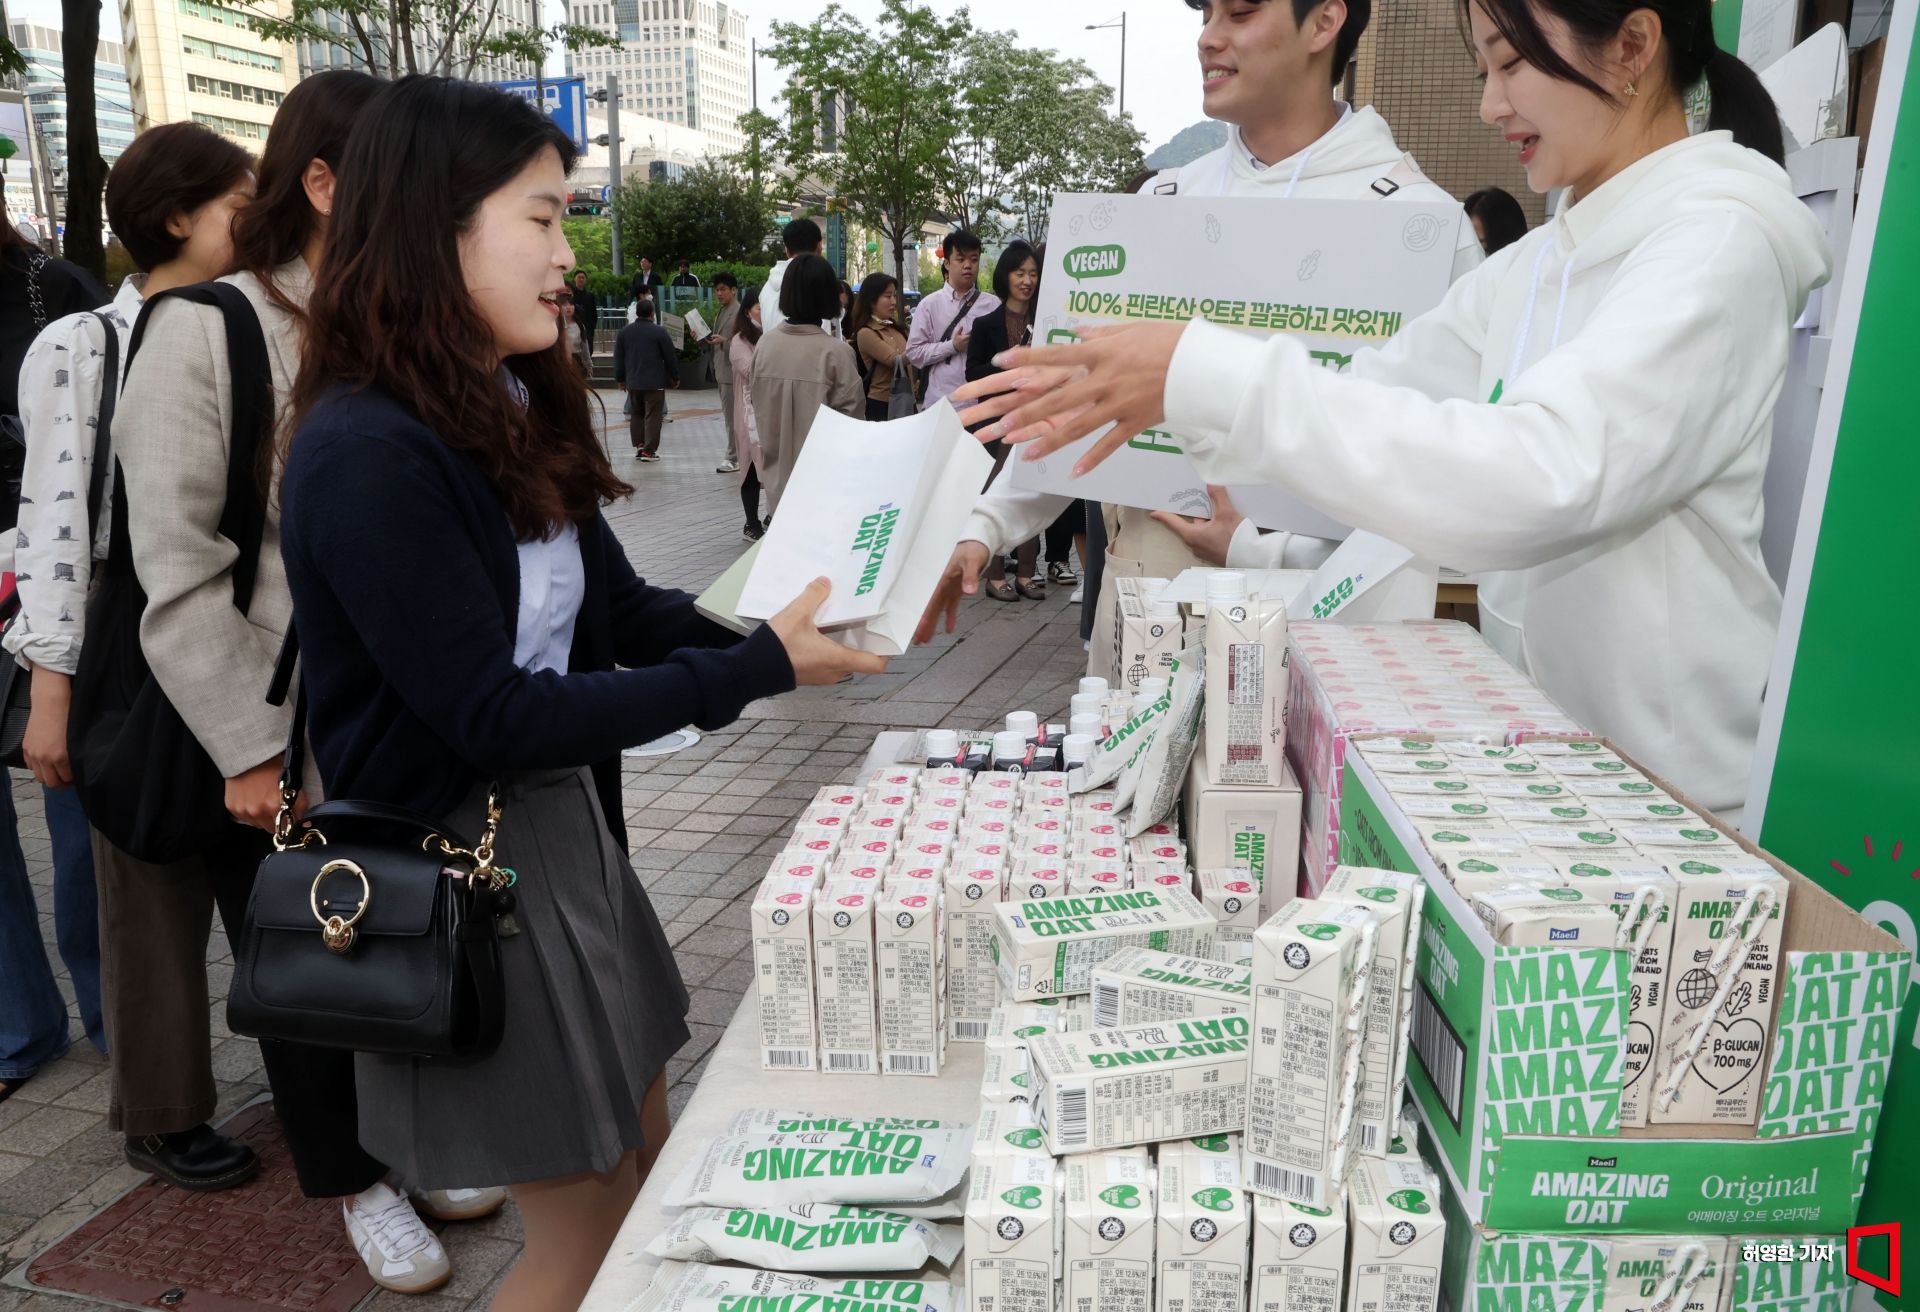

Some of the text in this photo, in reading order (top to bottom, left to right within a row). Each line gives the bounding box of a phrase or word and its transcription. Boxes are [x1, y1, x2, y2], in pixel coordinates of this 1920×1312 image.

[1070, 250, 1119, 273] VEGAN
[1068, 291, 1402, 338] 100% 핀란드산 오트로 깔끔하고 맛있게
[852, 513, 882, 551] OAT
[855, 508, 901, 597] AMAZING
[1022, 891, 1163, 920] AMAZING
[1030, 917, 1099, 937] OAT
[1551, 929, 1579, 940] Maeil
[1424, 917, 1460, 988] AMAZING
[1430, 956, 1447, 1000] OAT
[1758, 978, 1770, 1004] VEGAN
[1648, 981, 1660, 1007] VEGAN
[1713, 1055, 1752, 1069] 700 mg
[840, 1131, 923, 1160] OAT
[742, 1148, 914, 1182] AMAZING
[1588, 1157, 1617, 1168] Maeil
[1531, 1172, 1670, 1198] AMAZING
[1701, 1168, 1818, 1206] Original
[1565, 1200, 1629, 1224] OAT
[1687, 1207, 1821, 1223] 어메이징 오트 오리지널
[725, 1209, 912, 1251] AMAZING
[833, 1280, 924, 1305] OAT
